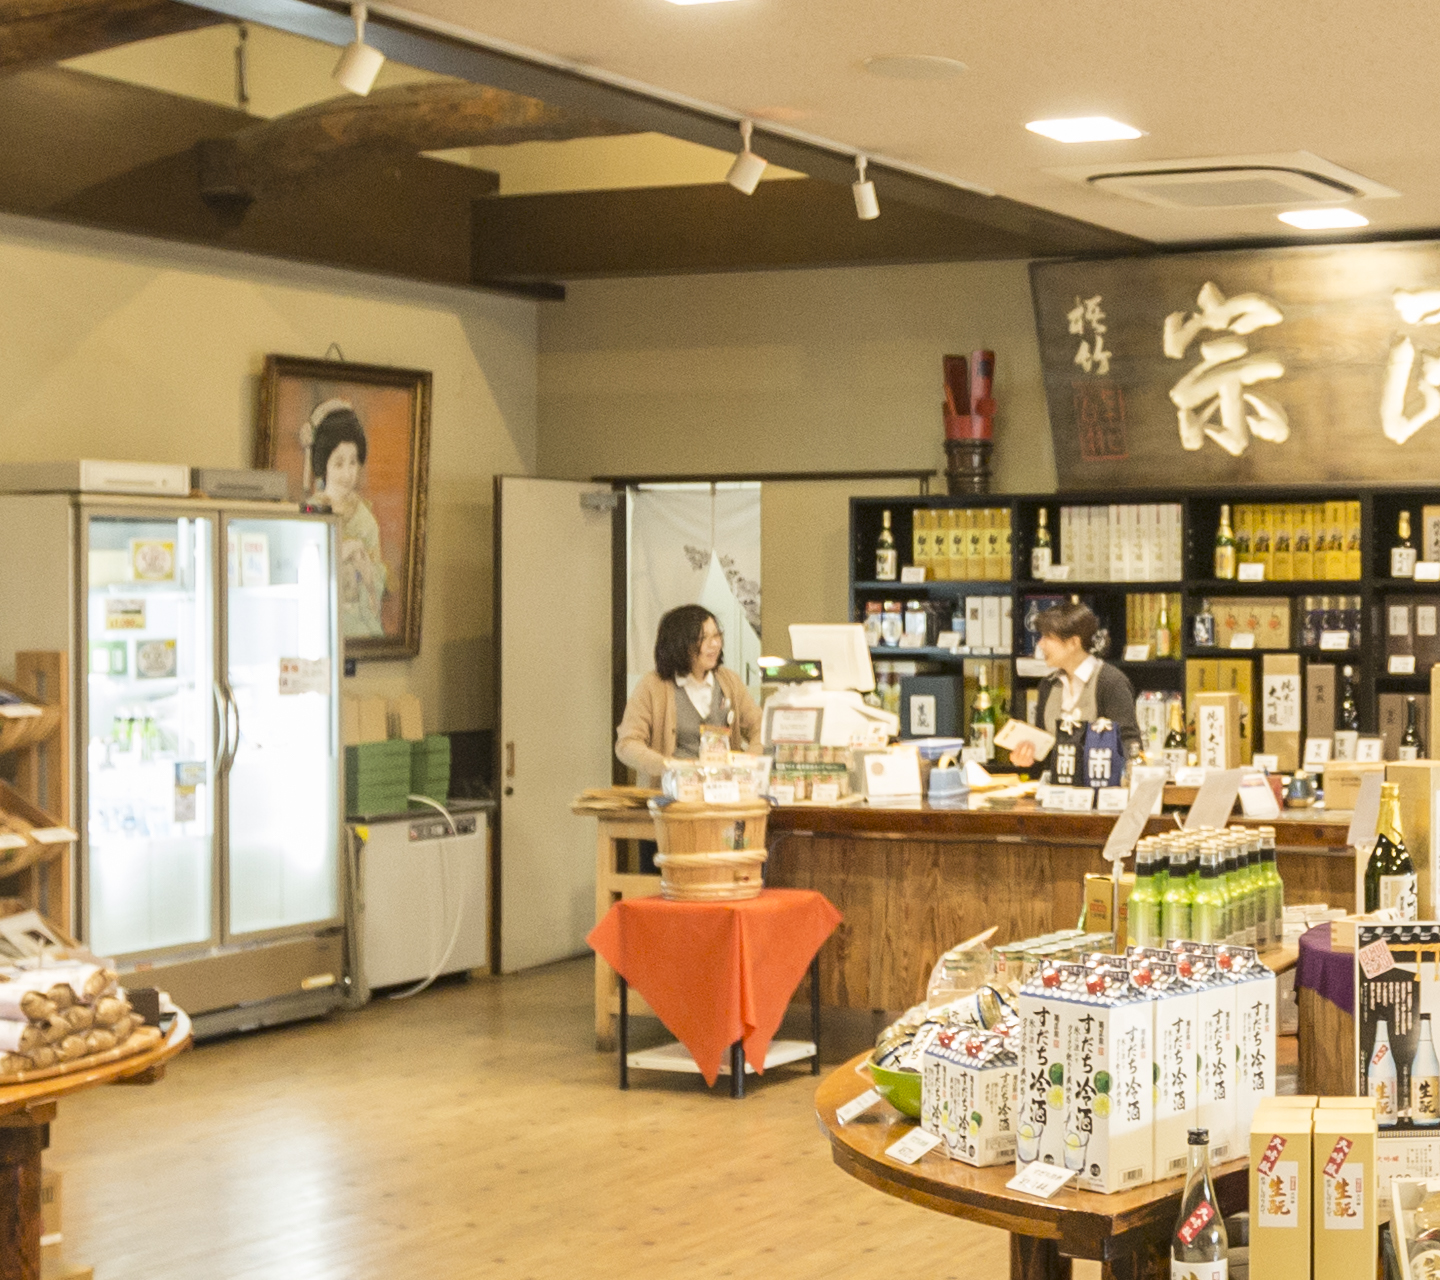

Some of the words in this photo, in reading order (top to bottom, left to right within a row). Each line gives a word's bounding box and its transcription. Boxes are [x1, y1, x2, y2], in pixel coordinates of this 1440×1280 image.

[1030, 1006, 1052, 1126] すだち冷酒
[1075, 1013, 1096, 1135] すだち冷酒
[1125, 1025, 1142, 1122] すだち冷酒
[1171, 1017, 1188, 1111] すだち冷酒
[1211, 1008, 1227, 1101] すだち冷酒
[1251, 1000, 1267, 1091] すだち冷酒
[998, 1072, 1011, 1132] すだち冷酒
[1267, 1174, 1291, 1216] 生酛
[1333, 1177, 1357, 1218] 生酛
